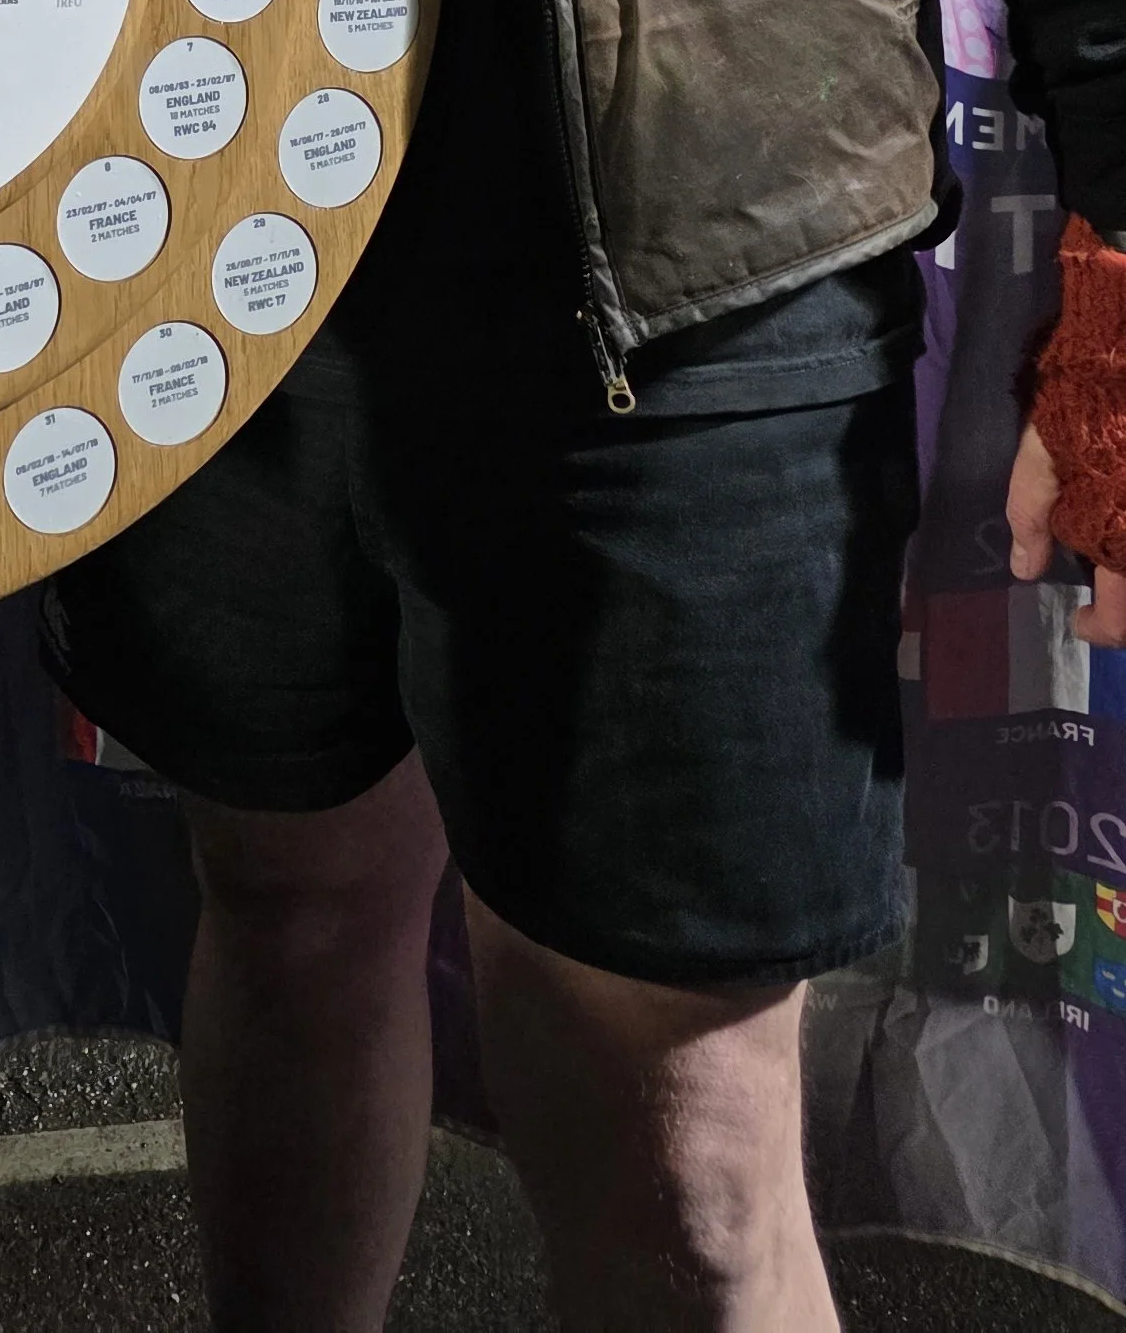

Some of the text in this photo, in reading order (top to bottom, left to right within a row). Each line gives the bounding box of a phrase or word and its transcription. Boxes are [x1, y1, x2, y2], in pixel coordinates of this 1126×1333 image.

[330, 8, 406, 22] NEW ZEALAND
[166, 91, 220, 109] ENGLAND
[174, 120, 216, 137] RWC 94
[304, 138, 356, 160] ENGLAND
[89, 210, 137, 230] FRANCE
[224, 262, 304, 288] NEW ZEALAND
[248, 294, 286, 312] RWC 17
[160, 329, 172, 338] 30
[149, 374, 195, 396] FRANCE
[45, 415, 55, 425] 31
[32, 457, 87, 487] ENGLAND
